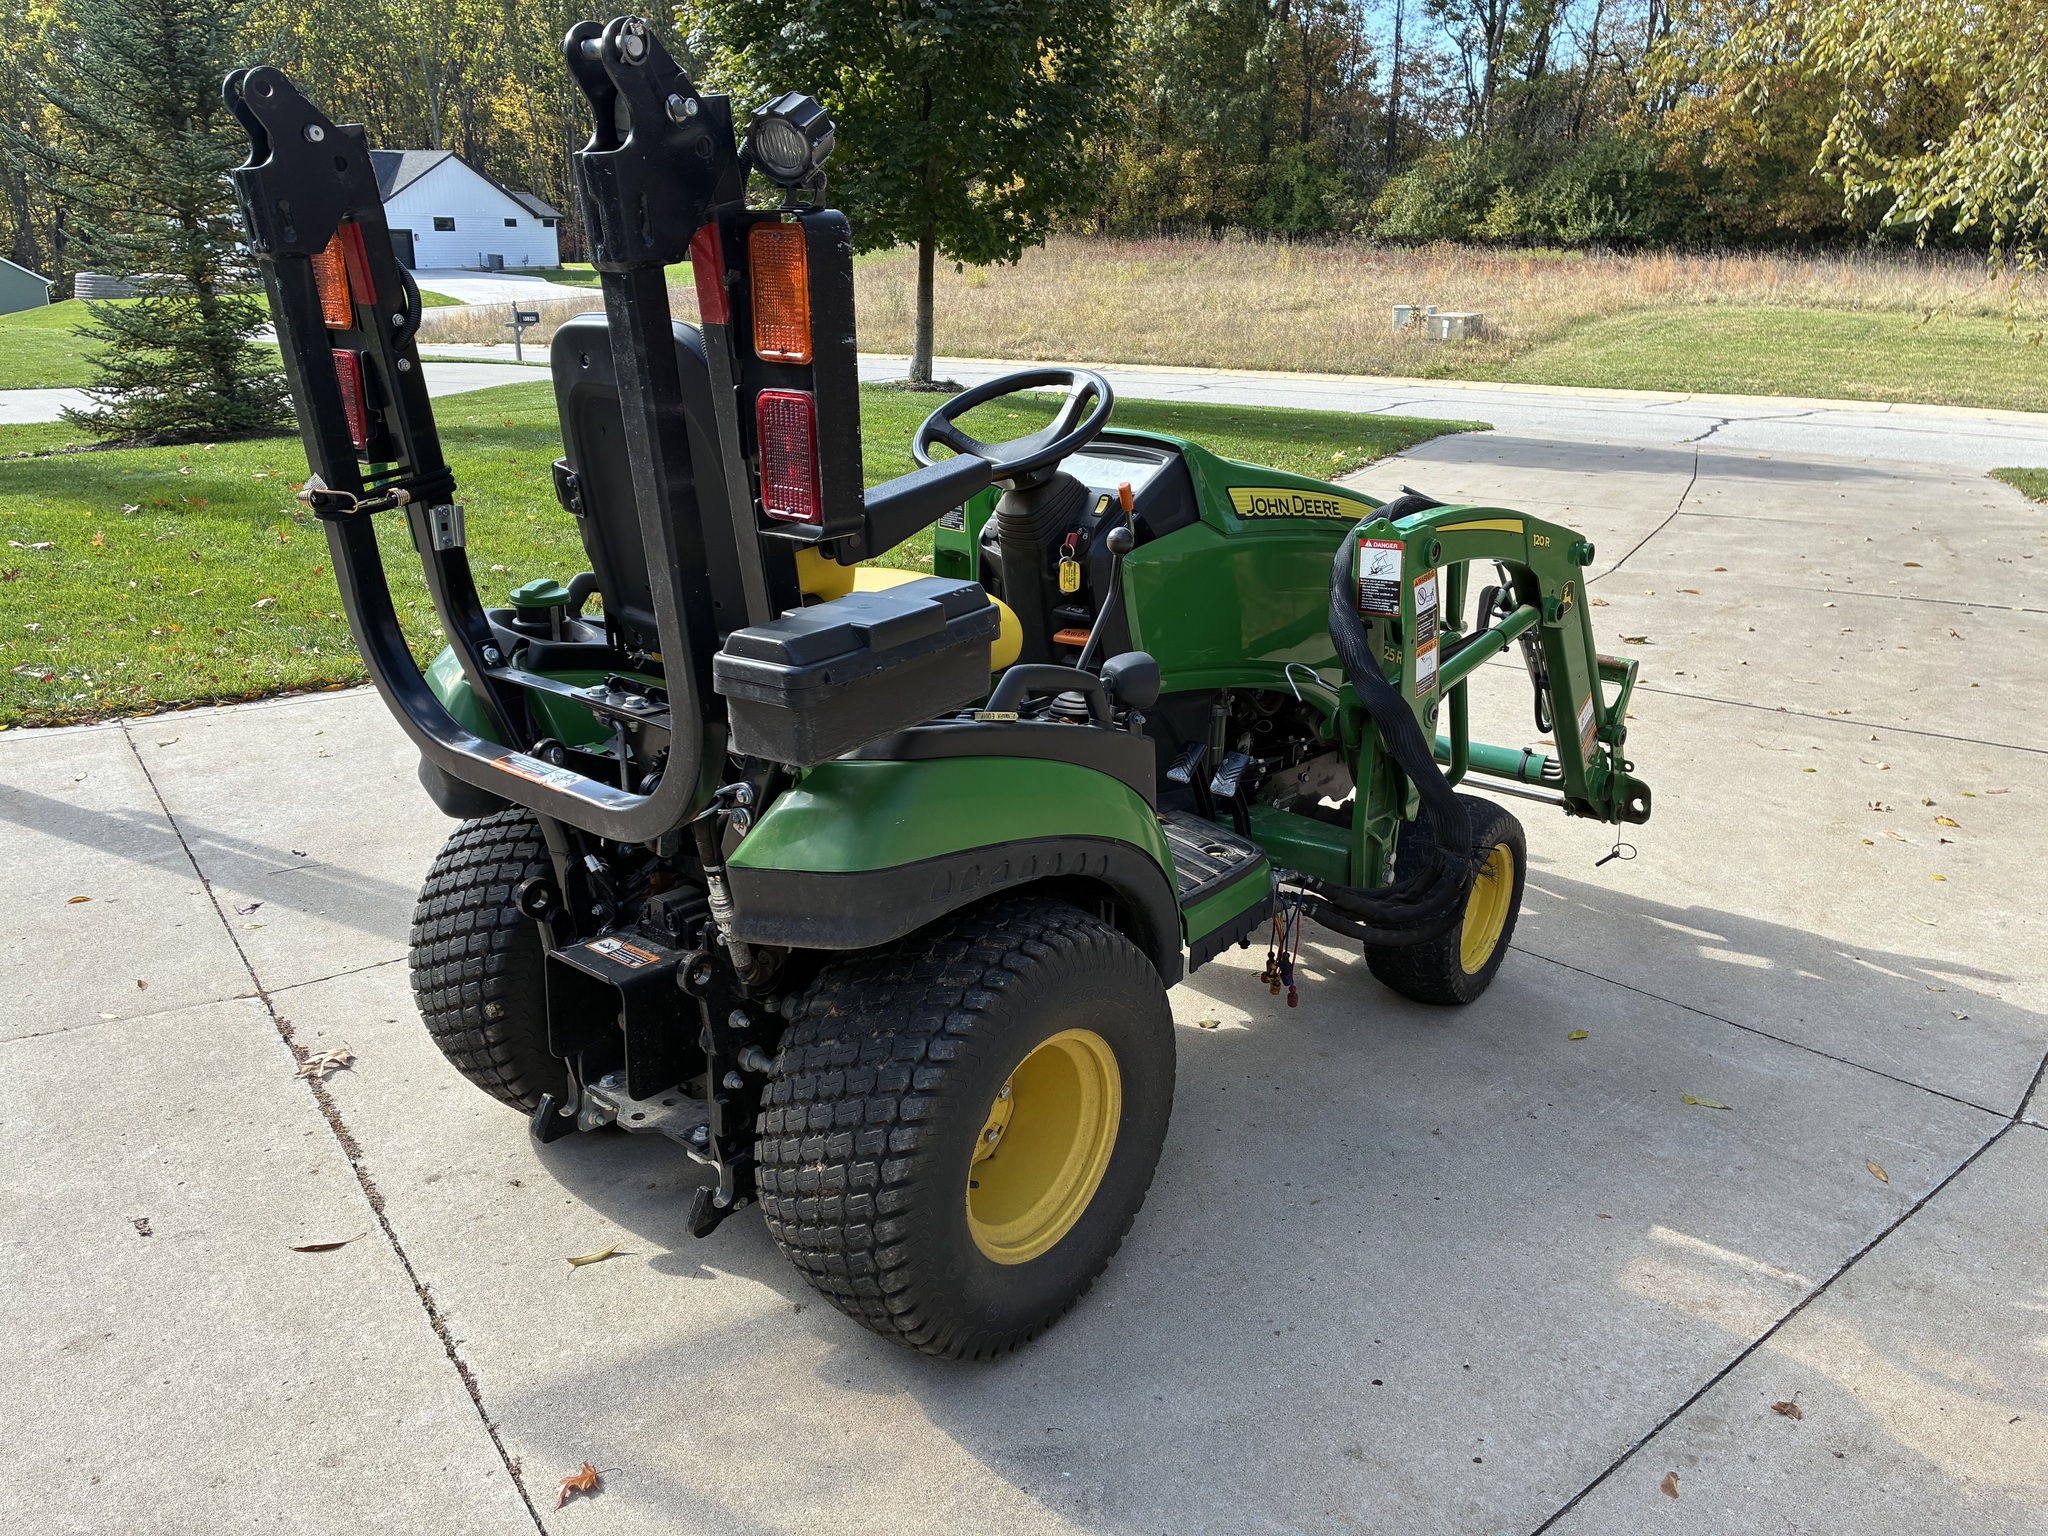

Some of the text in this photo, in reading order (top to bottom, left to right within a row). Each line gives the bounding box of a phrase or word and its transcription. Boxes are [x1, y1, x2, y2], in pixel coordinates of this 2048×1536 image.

[1247, 495, 1342, 516] JOHN DEERE
[1373, 541, 1398, 549] DANGER
